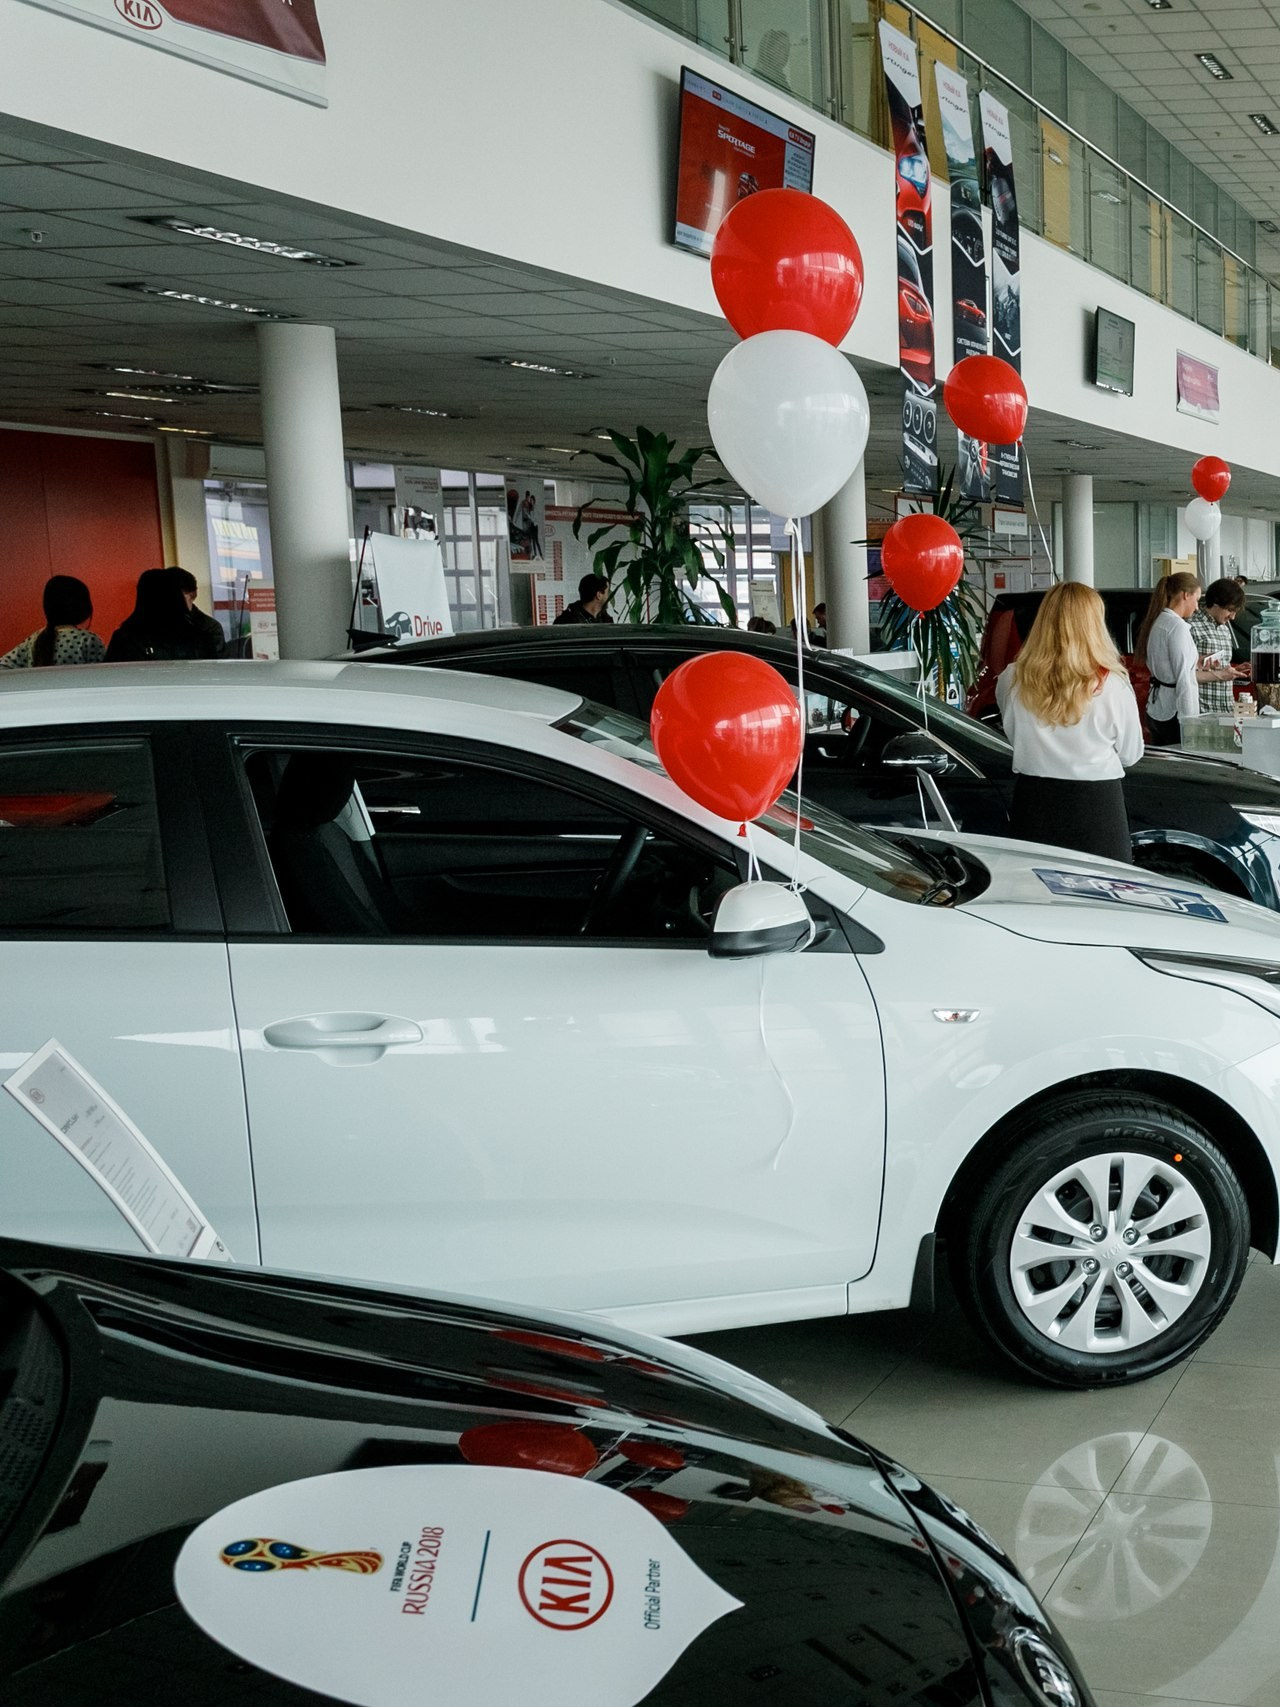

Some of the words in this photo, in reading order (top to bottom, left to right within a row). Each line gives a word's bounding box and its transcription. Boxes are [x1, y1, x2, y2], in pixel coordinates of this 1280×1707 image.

[124, 0, 155, 24] KIA
[717, 127, 756, 154] SPORTAGE
[414, 615, 443, 637] Drive
[400, 1541, 412, 1553] CUP
[416, 1526, 444, 1557] 2018
[394, 1553, 409, 1577] WORLD
[644, 1558, 661, 1593] Partner
[390, 1578, 402, 1592] FIFA
[402, 1560, 437, 1615] RUSSIA
[538, 1556, 593, 1614] KIA
[644, 1595, 661, 1630] Official
